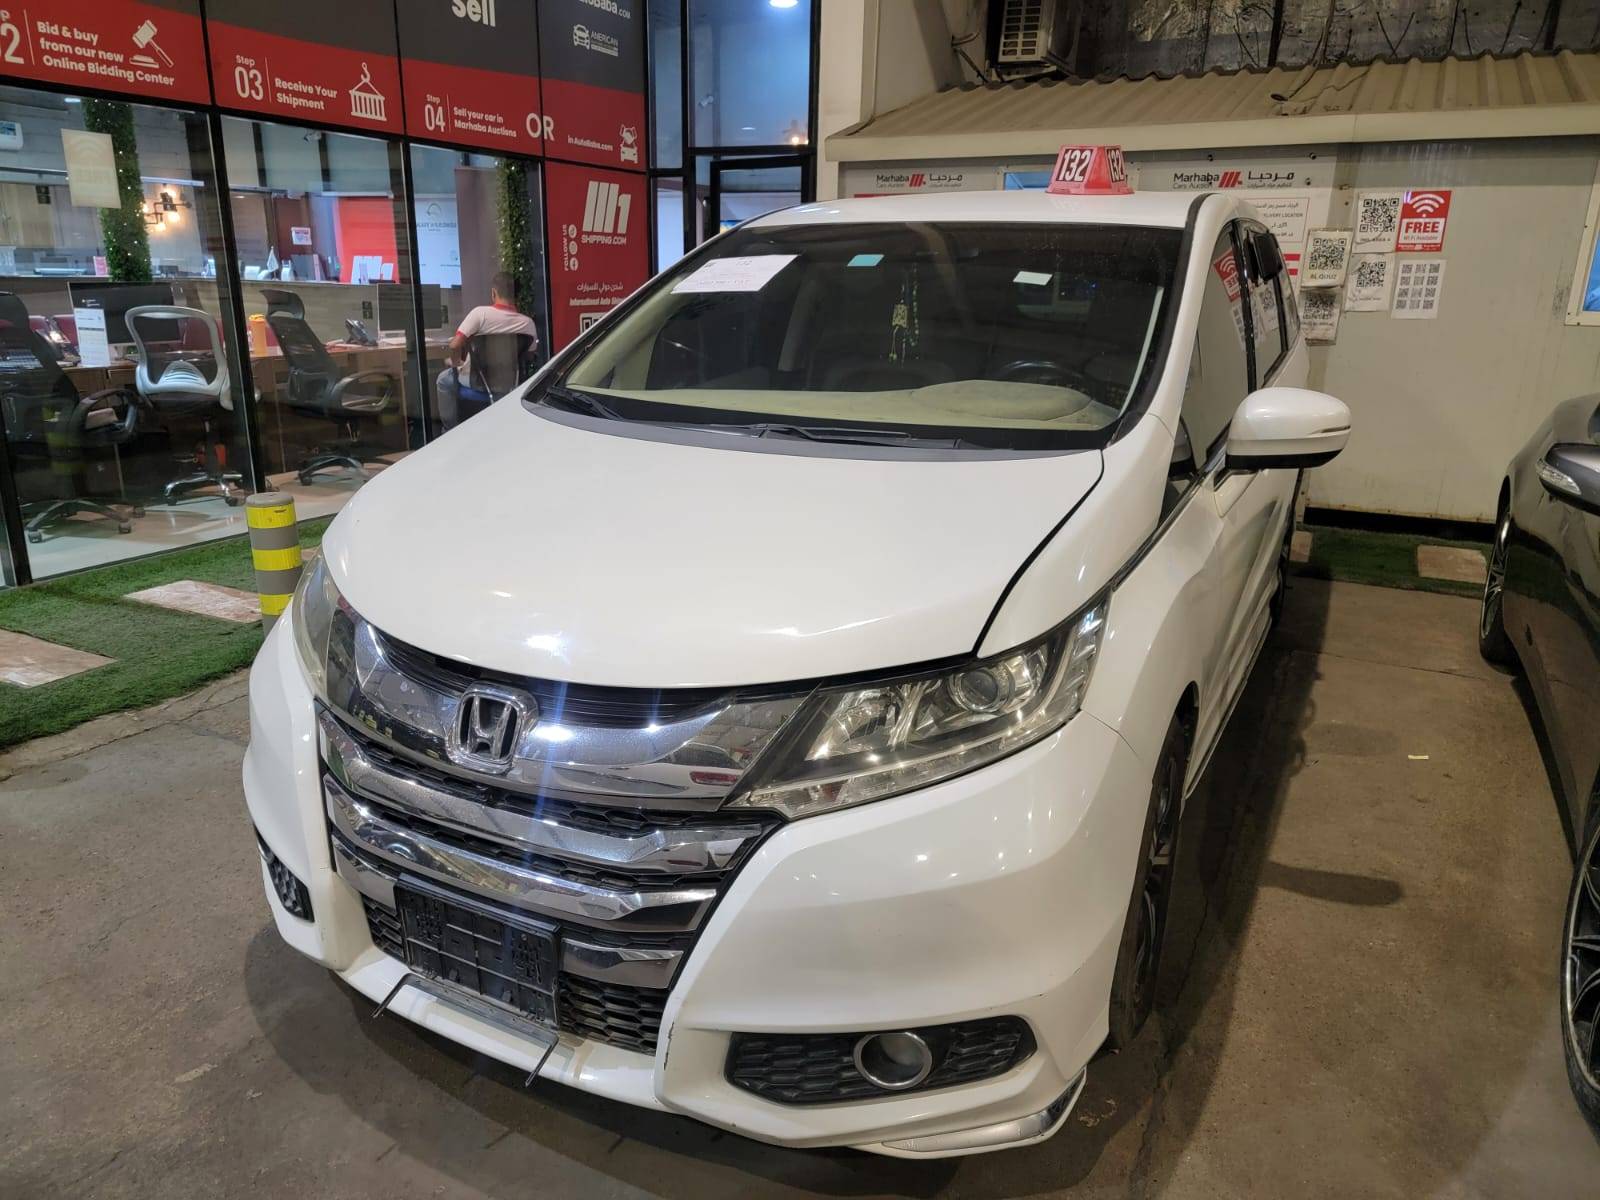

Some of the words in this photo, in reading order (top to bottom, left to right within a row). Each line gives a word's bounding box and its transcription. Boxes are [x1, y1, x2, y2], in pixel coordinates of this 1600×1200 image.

[37, 21, 59, 35] Bid
[62, 26, 72, 38] &
[74, 28, 98, 46] buy
[40, 37, 73, 54] from
[75, 46, 96, 58] our
[99, 50, 124, 63] new
[235, 54, 255, 67] Step
[43, 55, 86, 72] Online
[88, 62, 135, 83] Bidding
[136, 70, 175, 87] Center
[234, 66, 264, 101] 03
[275, 78, 314, 95] Receive
[315, 84, 338, 100] Your
[276, 92, 325, 110] Shipment
[426, 94, 441, 104] Step
[424, 104, 445, 133] 04
[453, 106, 466, 117] Sell
[466, 110, 484, 122] your
[484, 113, 497, 122] car
[497, 113, 504, 124] in
[454, 118, 487, 133] Marhaba
[487, 126, 517, 138] Auctions
[526, 112, 555, 142] OR
[567, 134, 574, 144] in
[1058, 149, 1092, 182] 132
[1107, 149, 1126, 182] 132
[876, 174, 909, 183] Marhaba
[929, 173, 963, 183] مرحبا
[1173, 172, 1219, 183] Marhaba
[1247, 170, 1295, 183] مرحبا
[1404, 221, 1440, 234] FREE
[581, 235, 626, 245] SHIPPING.COM
